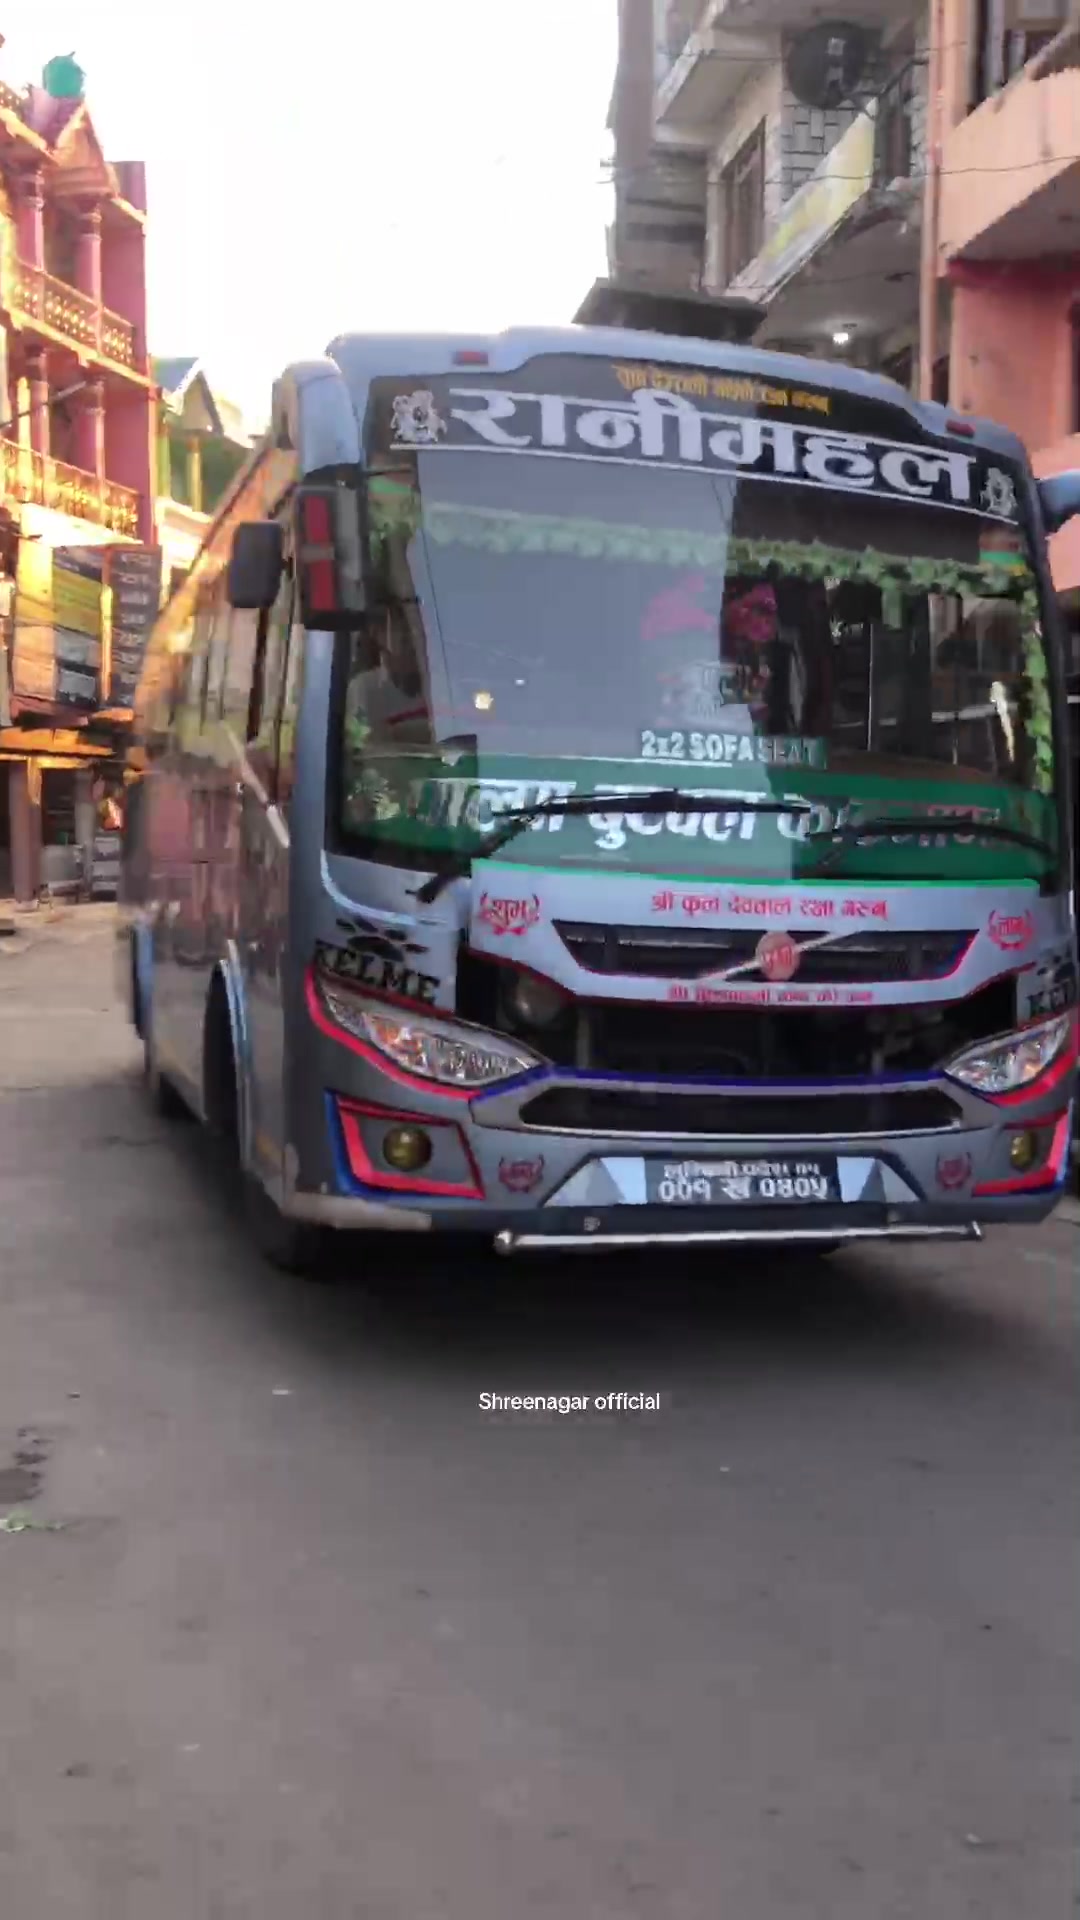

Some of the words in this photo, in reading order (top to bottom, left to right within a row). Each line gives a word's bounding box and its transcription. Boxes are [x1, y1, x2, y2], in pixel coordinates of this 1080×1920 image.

[448, 386, 976, 500] रानीमहल
[690, 732, 754, 760] SOFA
[314, 938, 440, 1005] KELME
